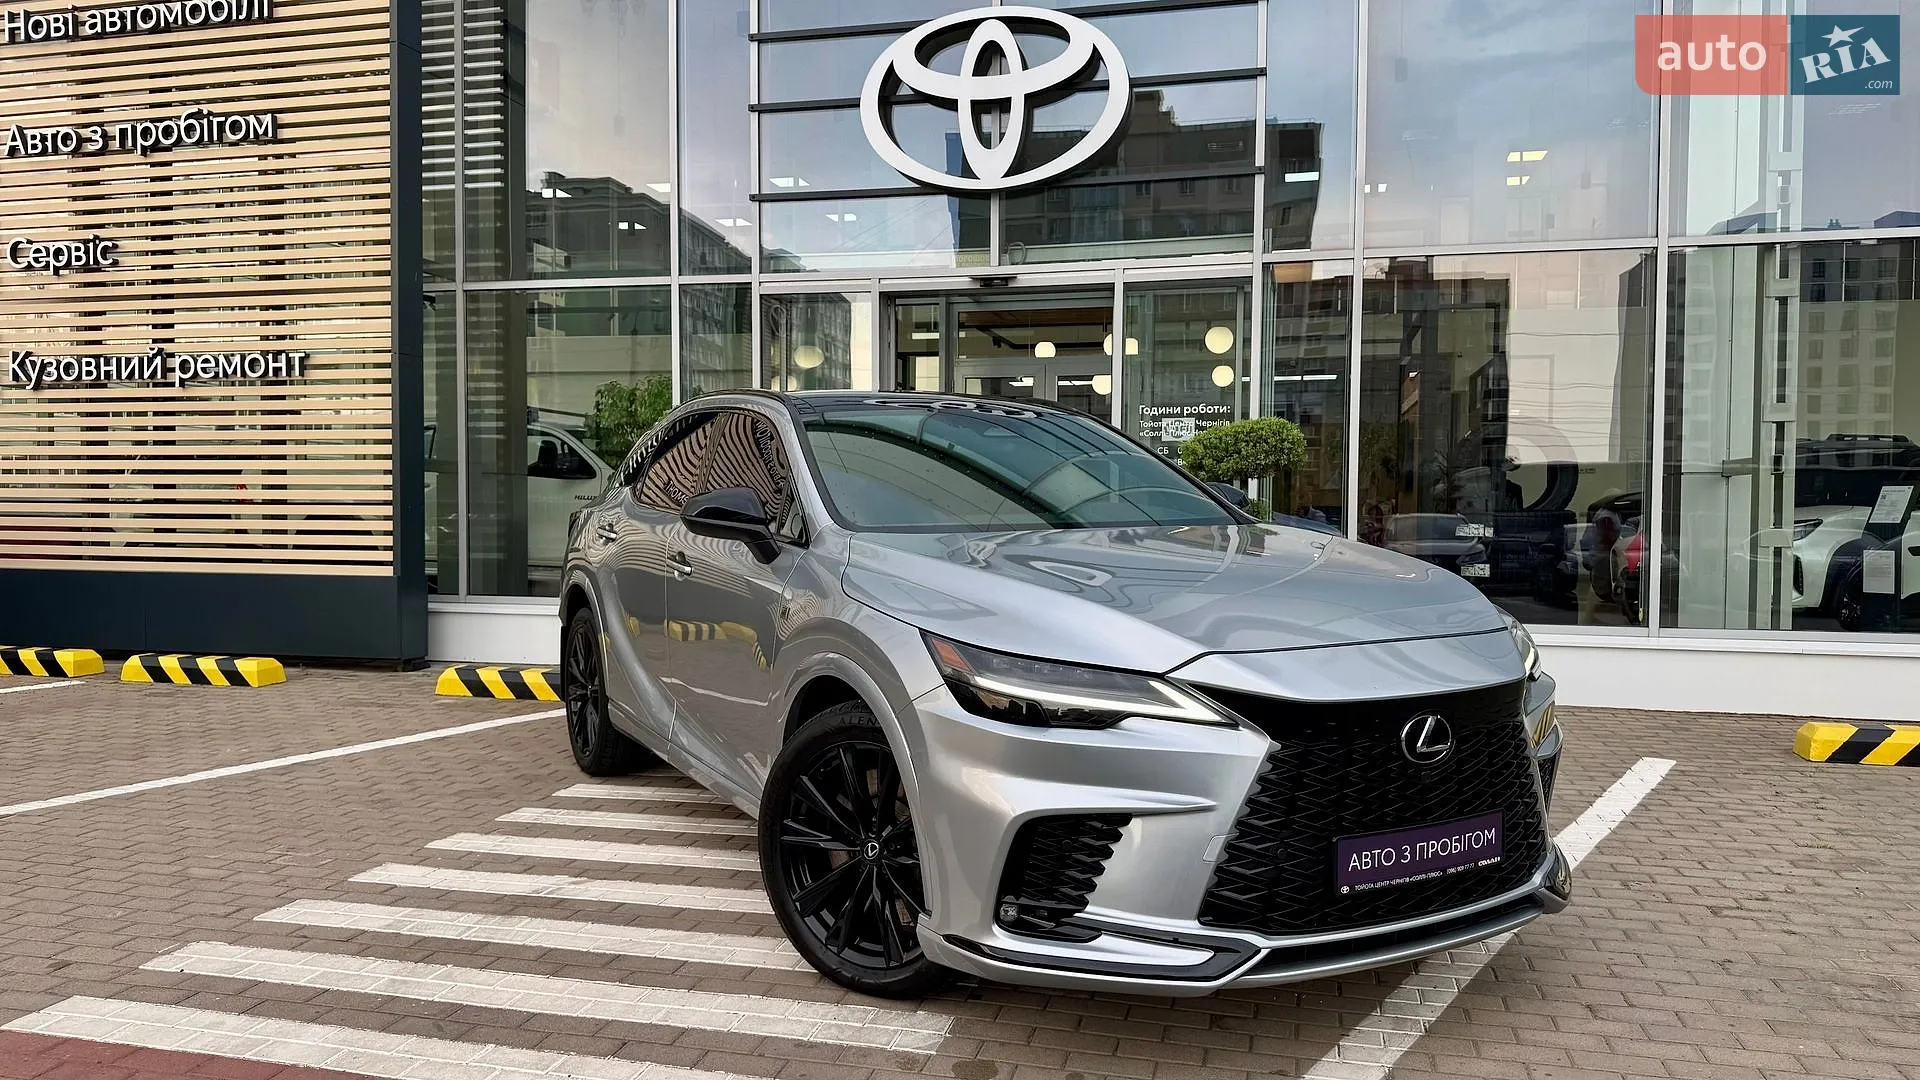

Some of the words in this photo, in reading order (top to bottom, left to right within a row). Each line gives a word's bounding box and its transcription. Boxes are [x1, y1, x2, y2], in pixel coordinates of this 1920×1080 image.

[5, 4, 73, 42] Нові
[4, 124, 77, 157] Авто
[88, 125, 103, 150] з
[115, 108, 274, 156] пробігом
[6, 233, 113, 276] Сервіс
[8, 346, 163, 390] Кузовний
[174, 350, 306, 388] ремонт
[1139, 404, 1181, 416] Години
[1183, 403, 1231, 416] роботи:
[1157, 446, 1169, 455] СБ
[839, 716, 880, 727] ALEN
[1348, 847, 1396, 872] АВТО
[1400, 845, 1411, 863] З
[1416, 828, 1496, 861] ПРОБІГОМ
